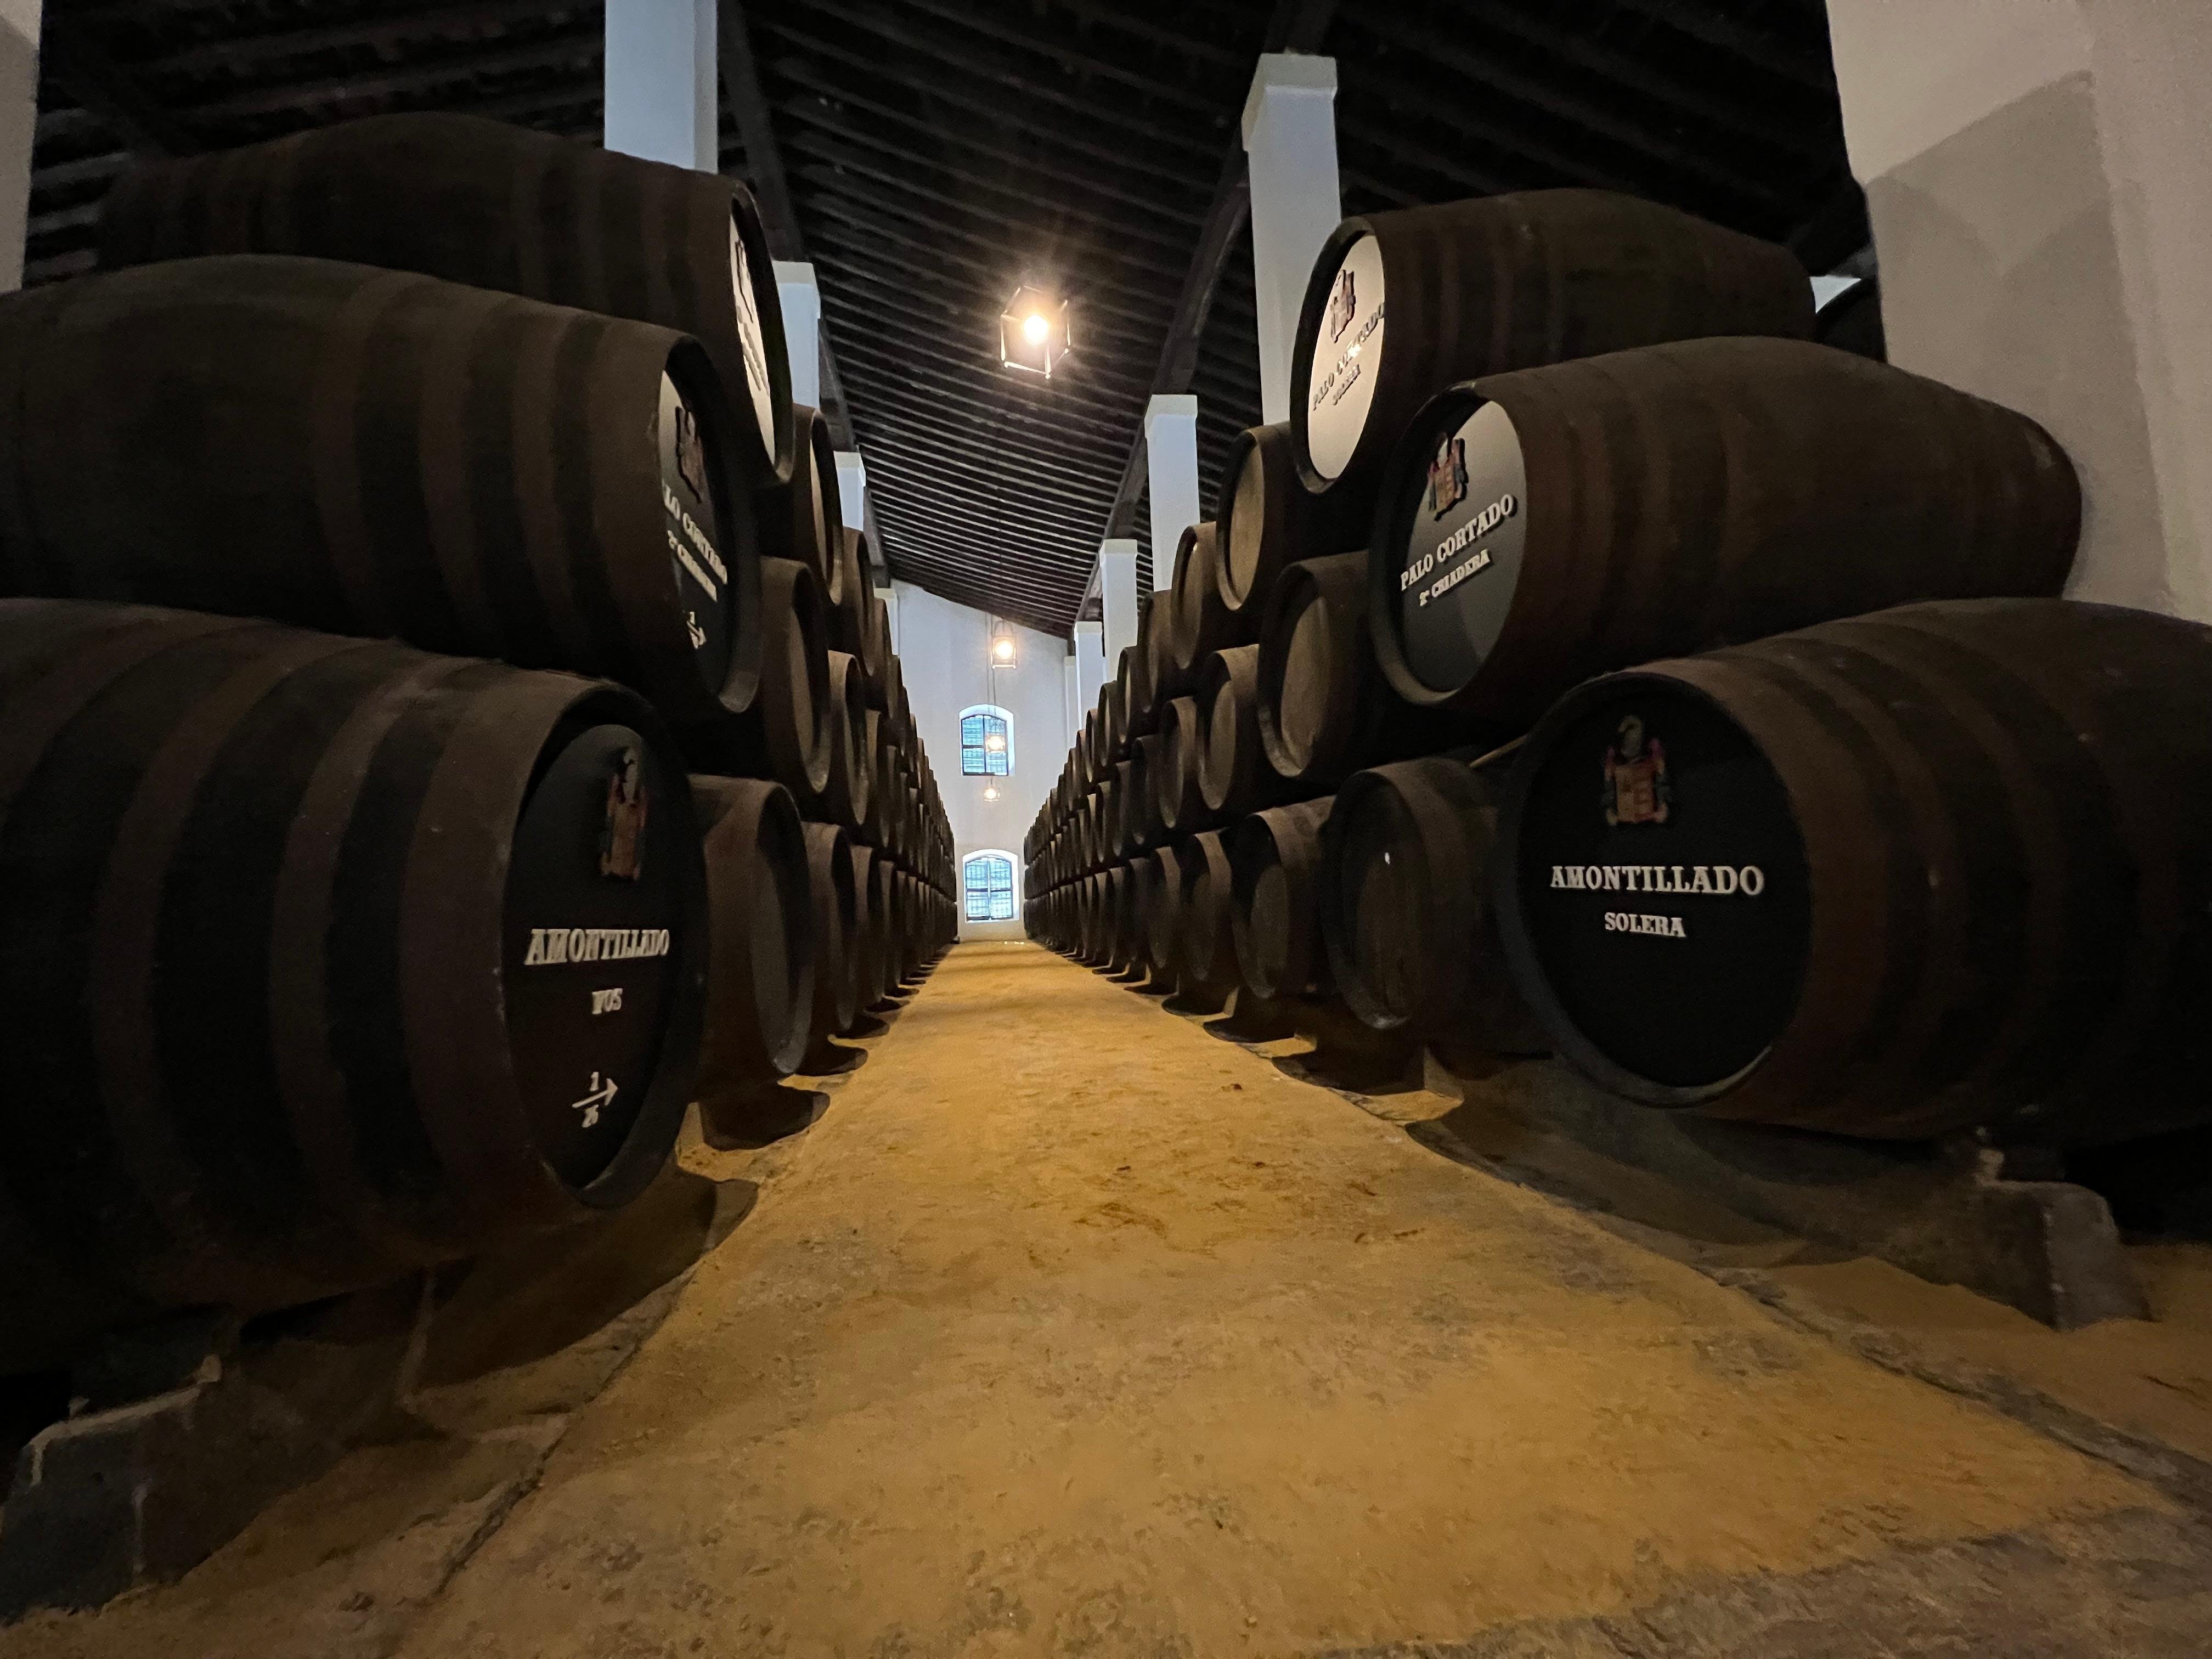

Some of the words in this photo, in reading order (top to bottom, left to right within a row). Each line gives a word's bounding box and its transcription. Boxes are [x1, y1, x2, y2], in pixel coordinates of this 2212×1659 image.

[1400, 554, 1434, 591] PALO
[1437, 494, 1514, 563] CORTADO
[1431, 549, 1491, 598] CRIADERA
[1549, 865, 1765, 896] AMONTILLADO
[1604, 911, 1688, 938] SOLERA
[524, 927, 670, 966] AMONTILLADO
